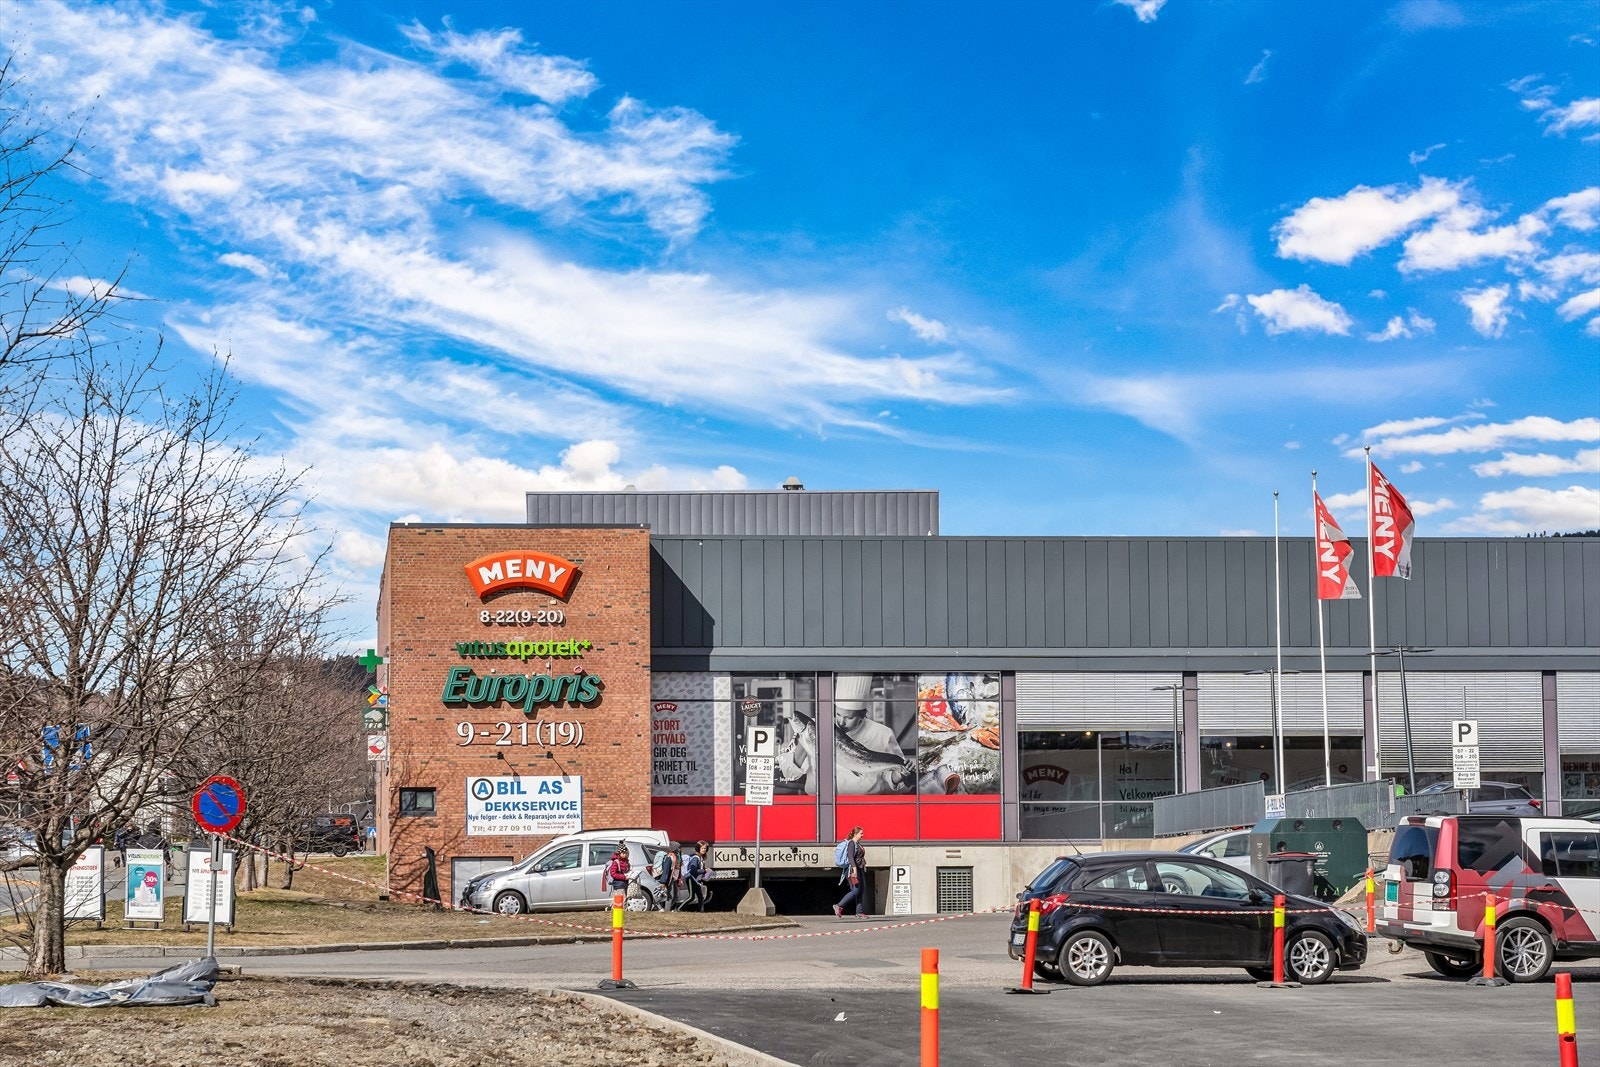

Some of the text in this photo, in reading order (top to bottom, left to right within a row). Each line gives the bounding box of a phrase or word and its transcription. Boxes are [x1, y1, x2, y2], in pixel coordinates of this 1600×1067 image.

[478, 559, 566, 585] MENY
[480, 609, 564, 623] 8-22(9-20)
[441, 665, 601, 713] Europris
[656, 703, 676, 711] MENY
[653, 719, 680, 730] STORT
[653, 733, 686, 744] UTVALG
[1458, 723, 1471, 742] P
[754, 730, 768, 752] P
[653, 747, 686, 757] GIR DEG
[653, 761, 698, 771] FRIHET TIL
[1563, 762, 1590, 772] DENNE
[653, 771, 688, 784] Å VELGE
[1026, 768, 1065, 780] MENY
[497, 781, 527, 795] BIL
[538, 780, 563, 794] AS
[1119, 787, 1176, 800] Velkomme
[485, 801, 578, 812] DEKKSERVICE
[896, 868, 906, 882] P
